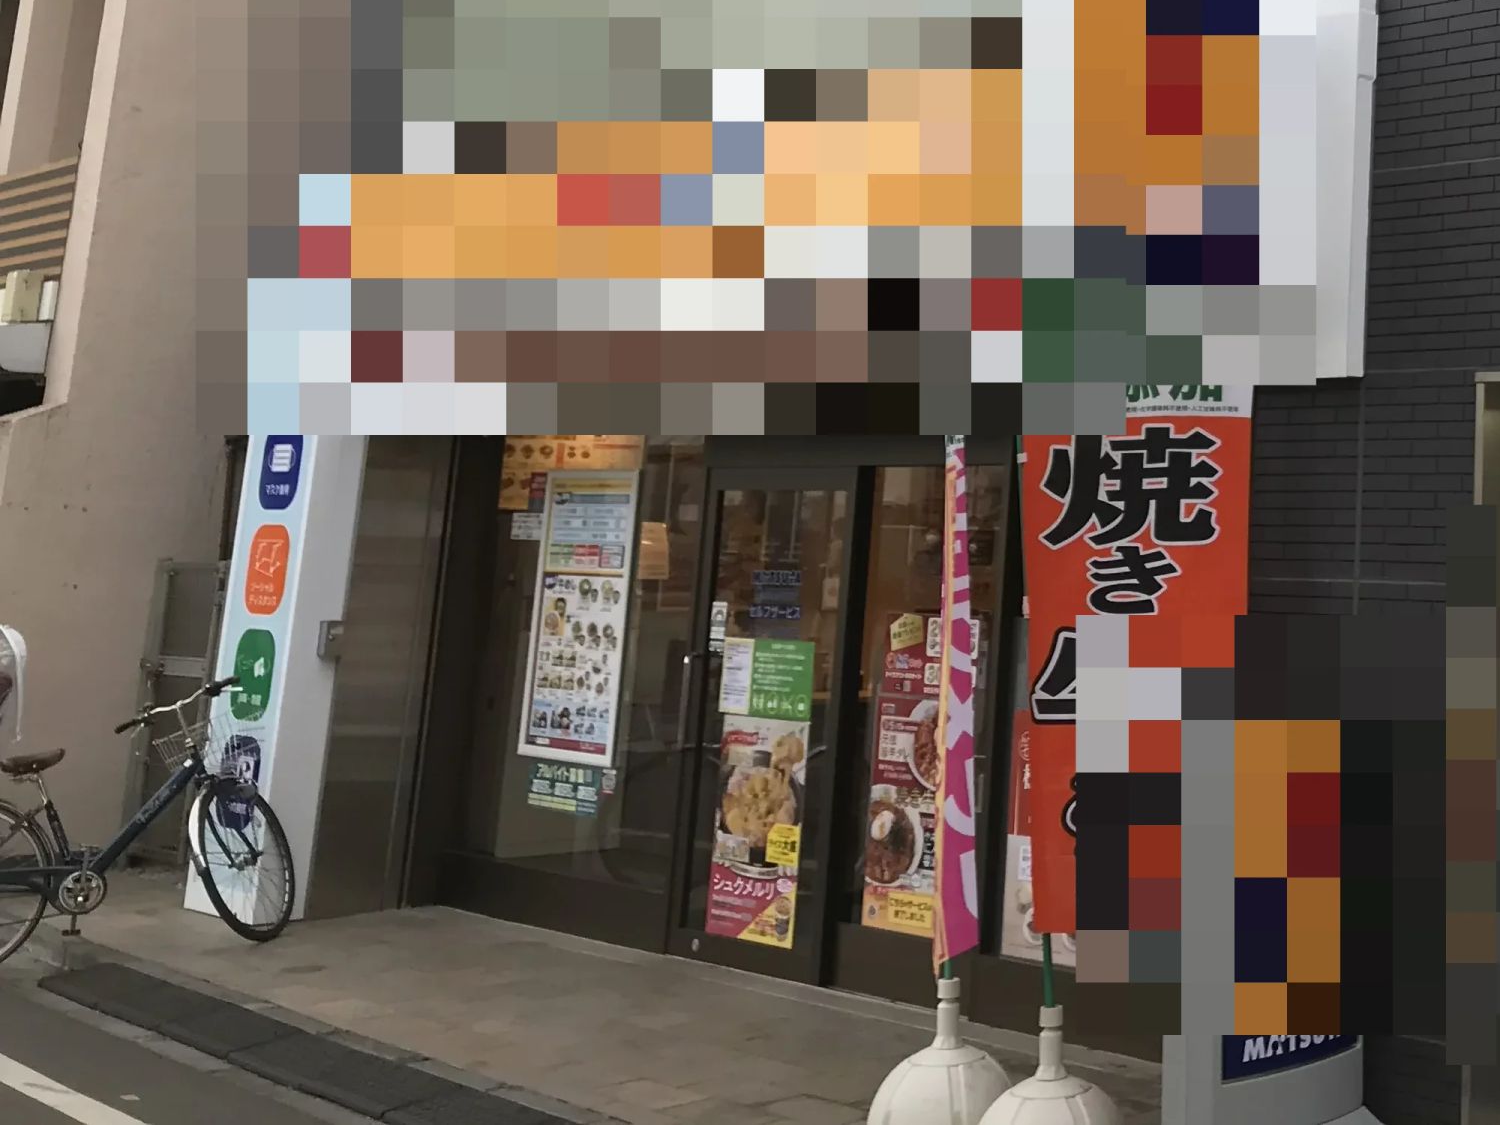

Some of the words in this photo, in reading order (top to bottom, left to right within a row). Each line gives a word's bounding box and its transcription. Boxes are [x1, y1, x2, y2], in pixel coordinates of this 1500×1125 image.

[712, 873, 775, 901] シュクメルリ
